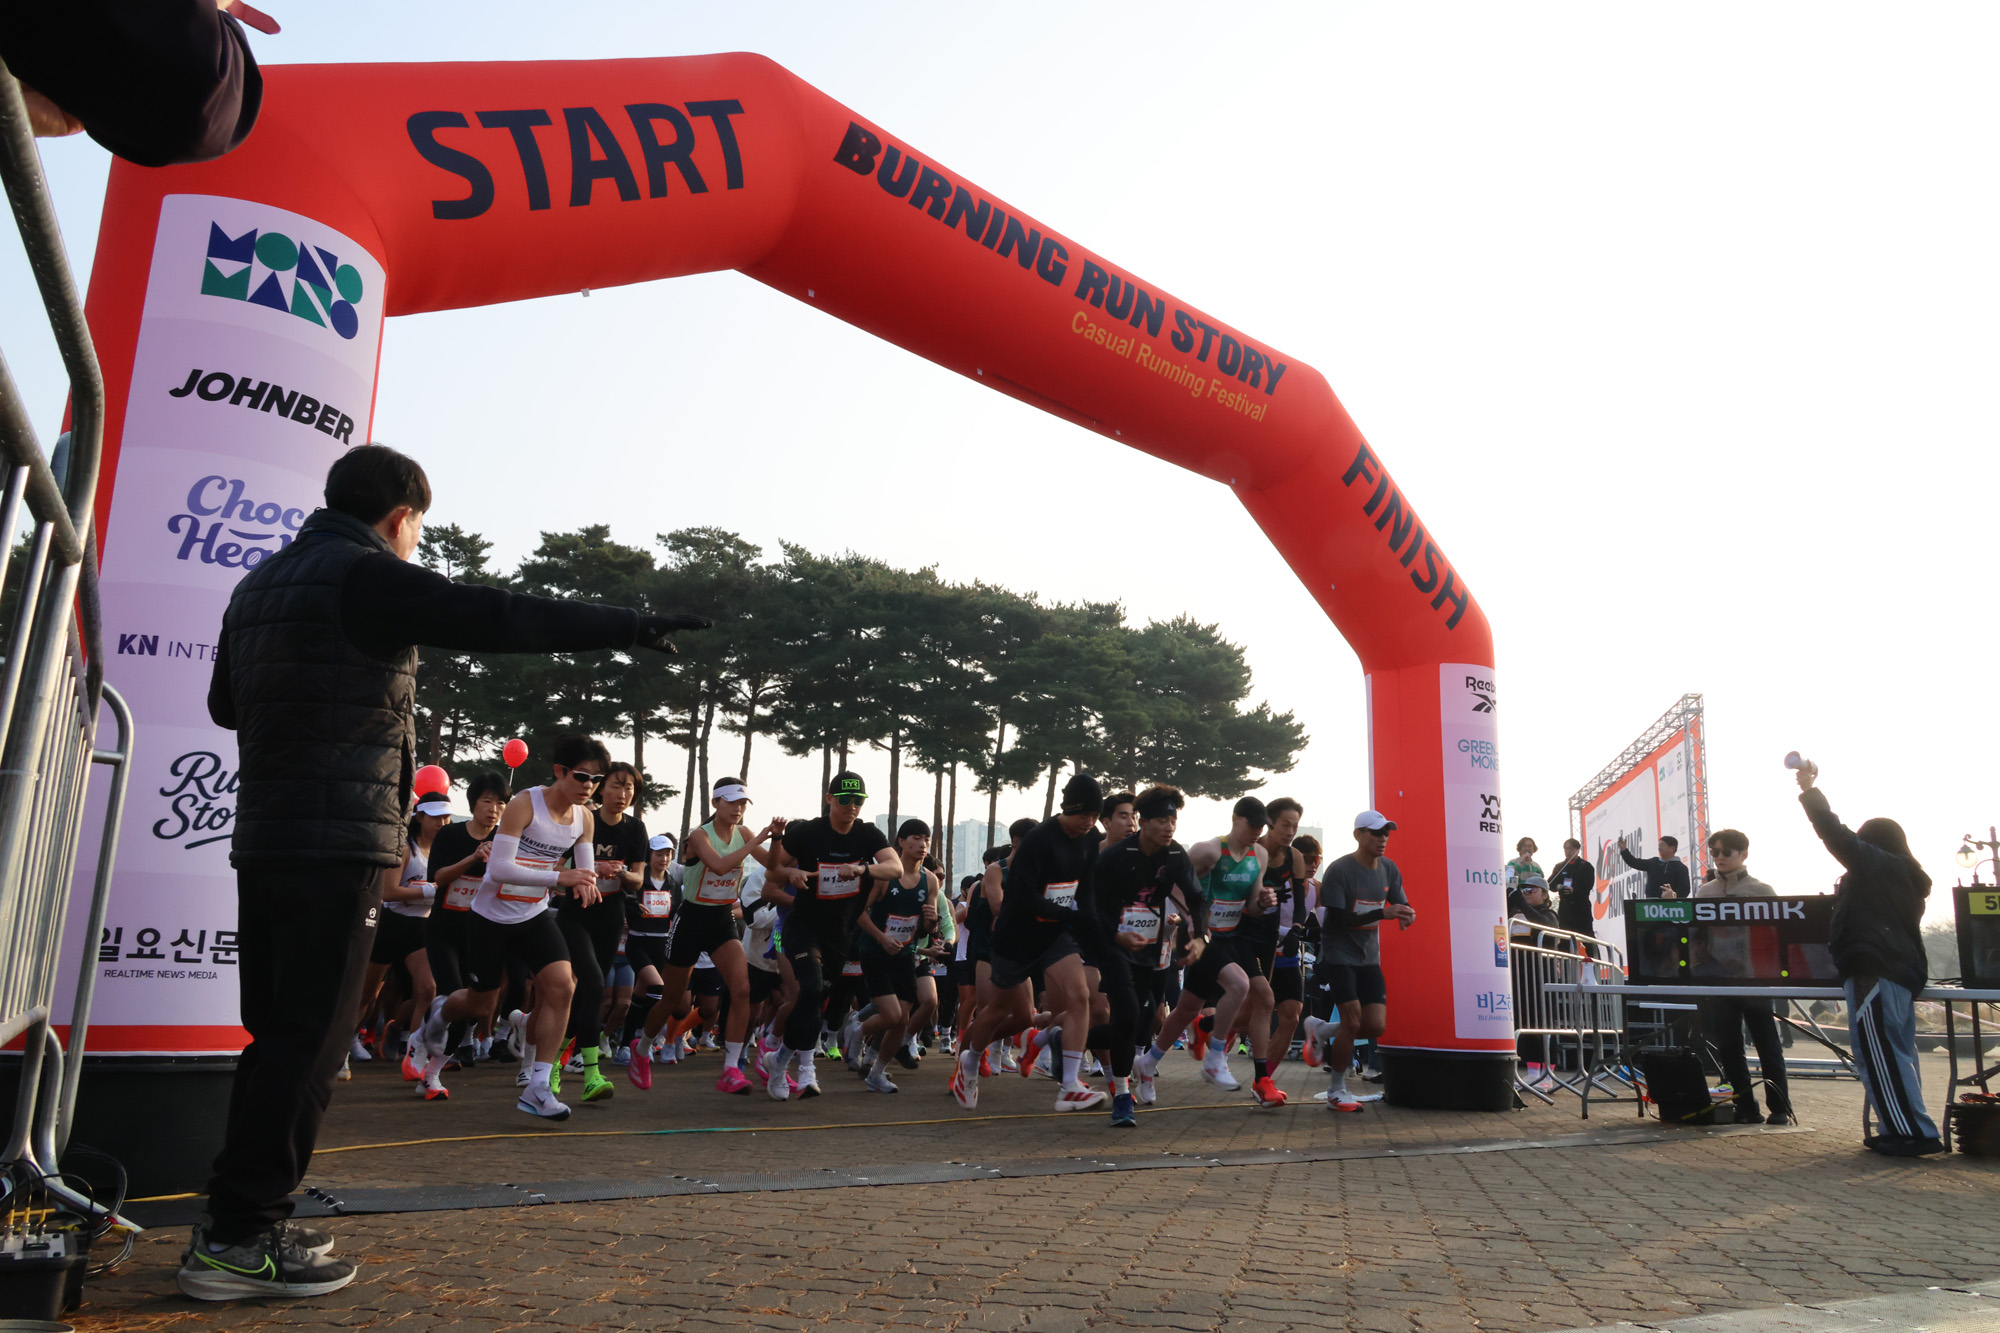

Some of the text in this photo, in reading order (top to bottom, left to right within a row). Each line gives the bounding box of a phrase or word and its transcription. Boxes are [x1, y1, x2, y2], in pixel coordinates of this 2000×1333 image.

[406, 98, 746, 220] START
[833, 121, 1287, 396] BURNING RUN STORY
[1072, 311, 1267, 422] Casual Running Festival
[168, 369, 354, 446] JOHNBER
[187, 475, 304, 531] Choc
[1341, 442, 1468, 630] FINISH
[118, 634, 219, 662] KN INTE
[1466, 676, 1496, 693] Reeb
[159, 751, 240, 800] Ru
[152, 794, 237, 839] Sto
[1480, 821, 1502, 834] REX
[1643, 904, 1685, 918] 10km
[1695, 901, 1805, 921] SAMIK
[98, 927, 239, 965] 일요신문
[104, 969, 218, 980] REALTIME NEWS MEDIA
